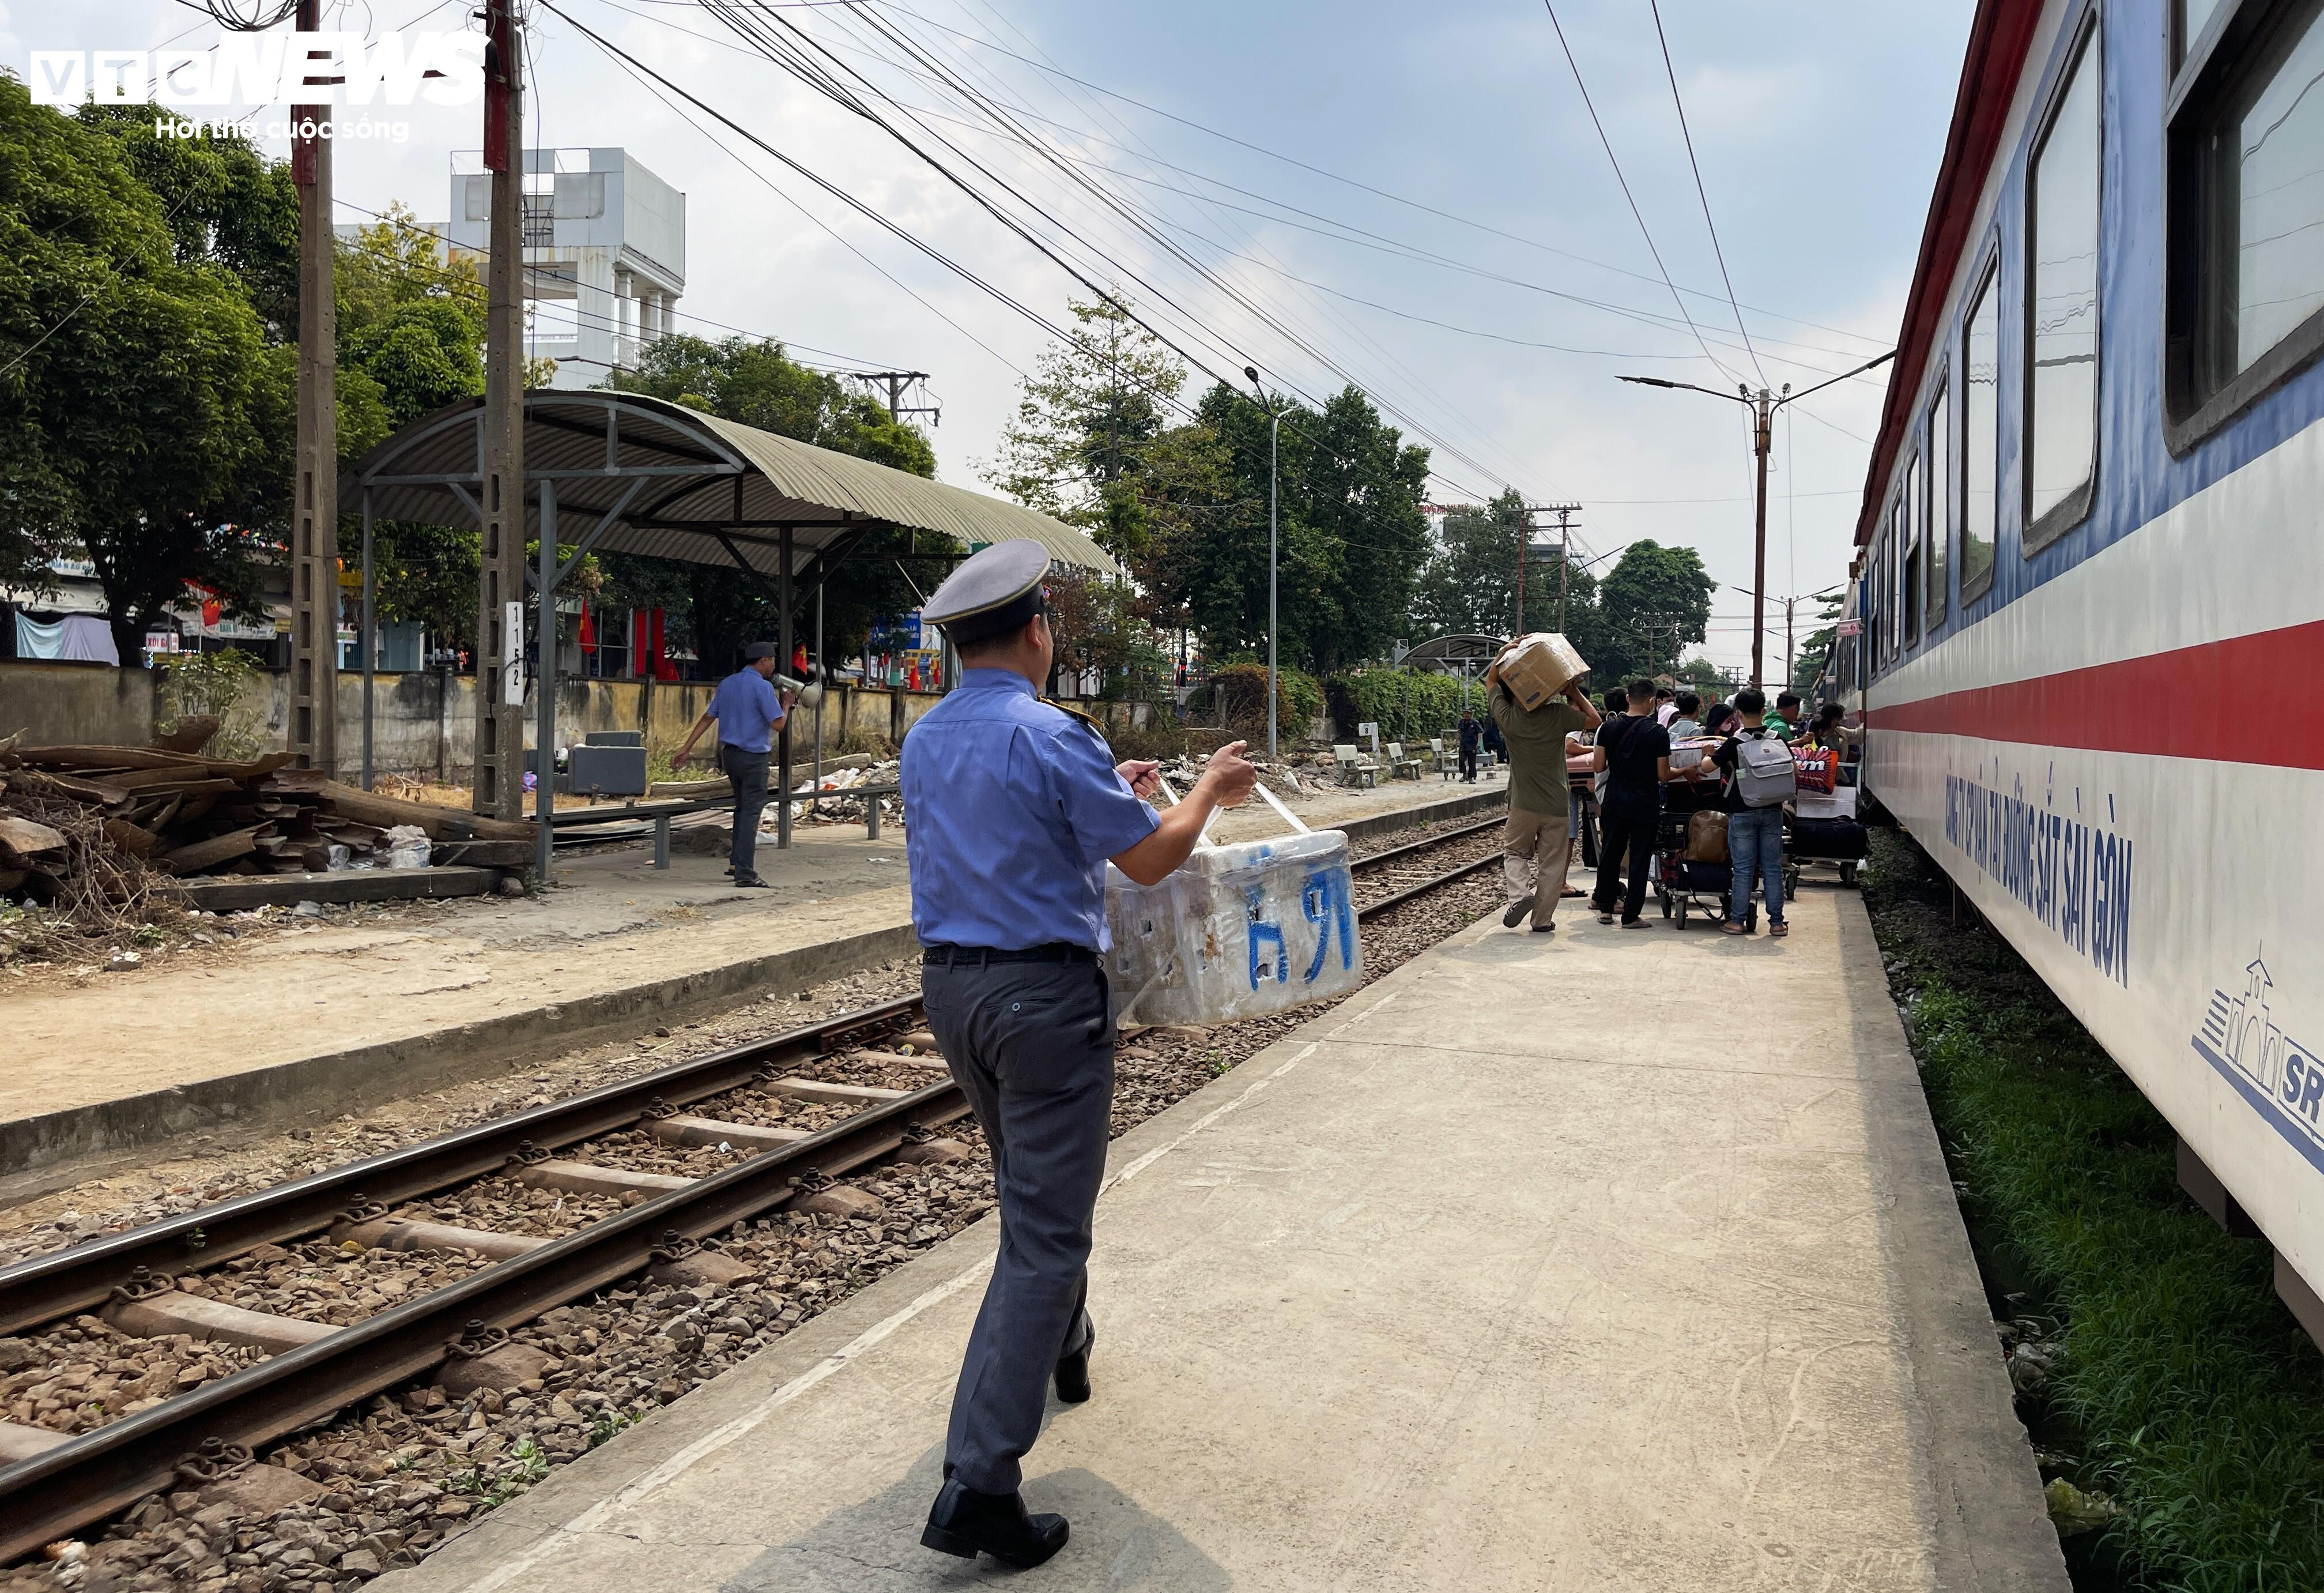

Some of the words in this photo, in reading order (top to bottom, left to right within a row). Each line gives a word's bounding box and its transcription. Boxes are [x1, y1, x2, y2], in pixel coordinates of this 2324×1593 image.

[1959, 777, 1966, 851] TY
[1967, 780, 1974, 857] CP
[1975, 763, 1988, 885] VẬN
[1989, 755, 2002, 883] TẢI
[2003, 772, 2035, 914] ĐƯỜNG
[2036, 761, 2061, 932] SẮT
[2062, 787, 2088, 956] SÀI
[2092, 793, 2132, 990] GÒN
